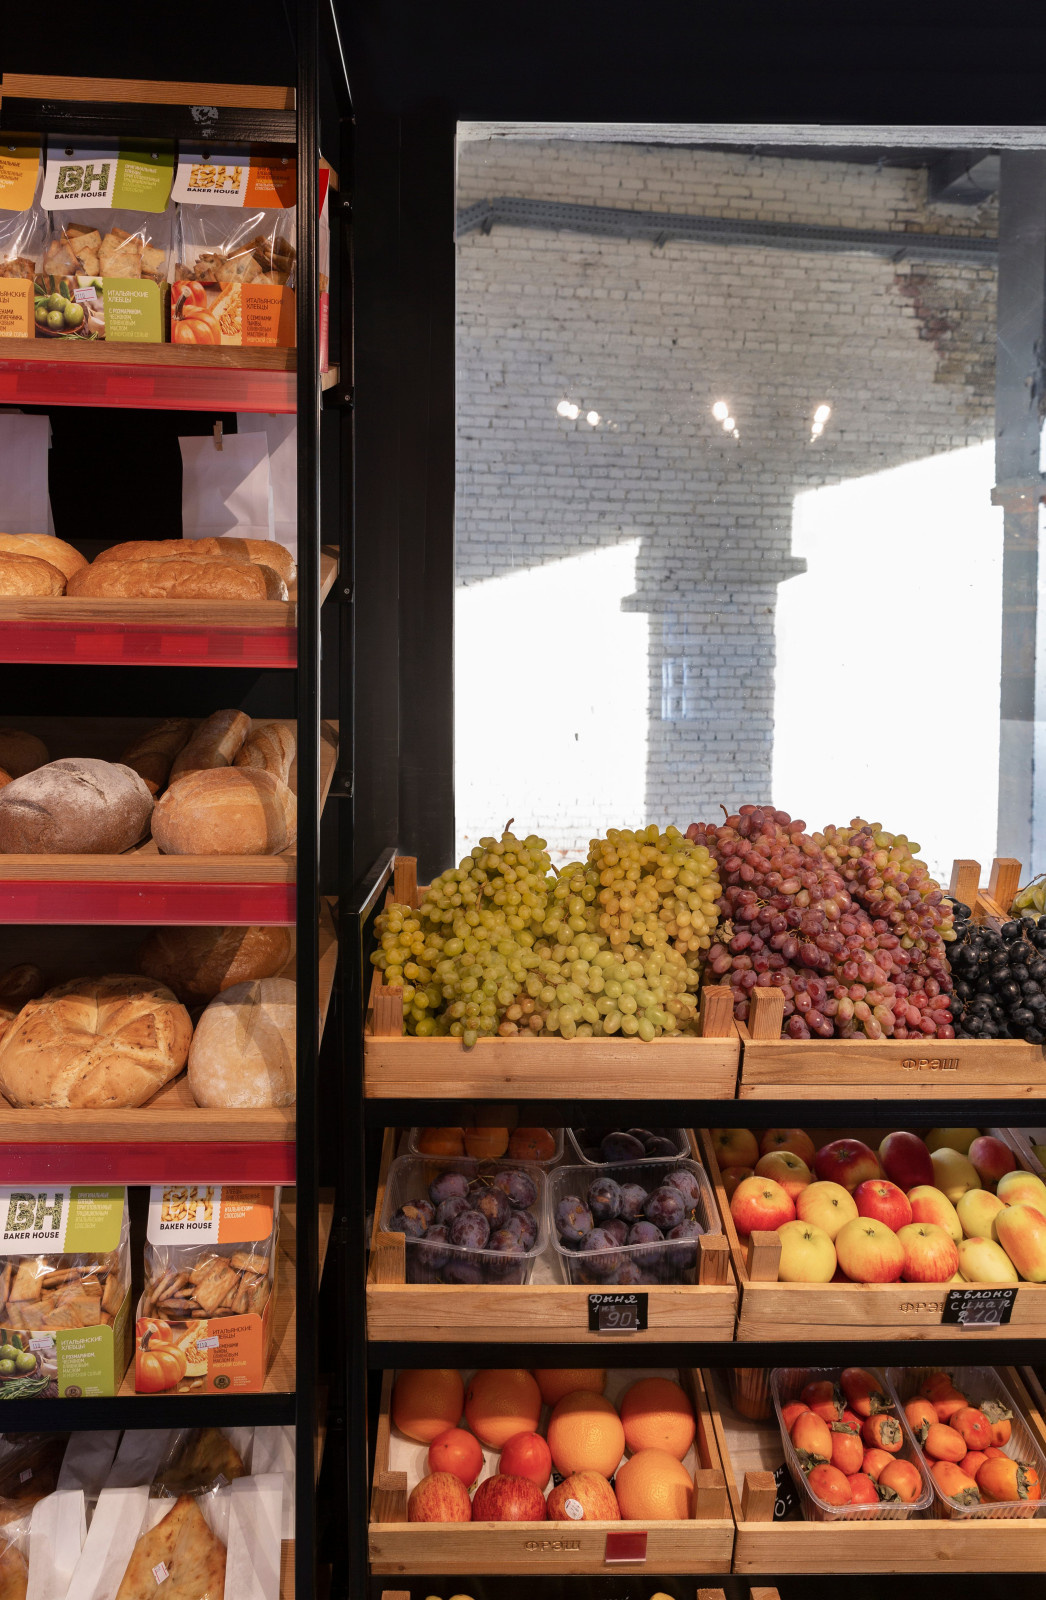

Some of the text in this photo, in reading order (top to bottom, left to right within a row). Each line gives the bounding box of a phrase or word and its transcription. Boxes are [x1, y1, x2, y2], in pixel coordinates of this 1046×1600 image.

[56, 164, 110, 193] BH
[54, 192, 79, 200] BAKER
[107, 290, 149, 298] ИТАЛЬЯНСКИЕ
[902, 1058, 959, 1071] ФРЭШ
[5, 1193, 64, 1231] BH
[160, 1222, 185, 1230] BAKER
[3, 1231, 60, 1240] BAKER HOUSE
[899, 1302, 944, 1313] ФРЭ
[606, 1312, 632, 1326] 90
[213, 1325, 252, 1335] ИТАЛЬЯНСКИЕ
[61, 1335, 102, 1346] ИТАЛЬЯНСКИЕ
[525, 1540, 580, 1551] ФРЭШ
